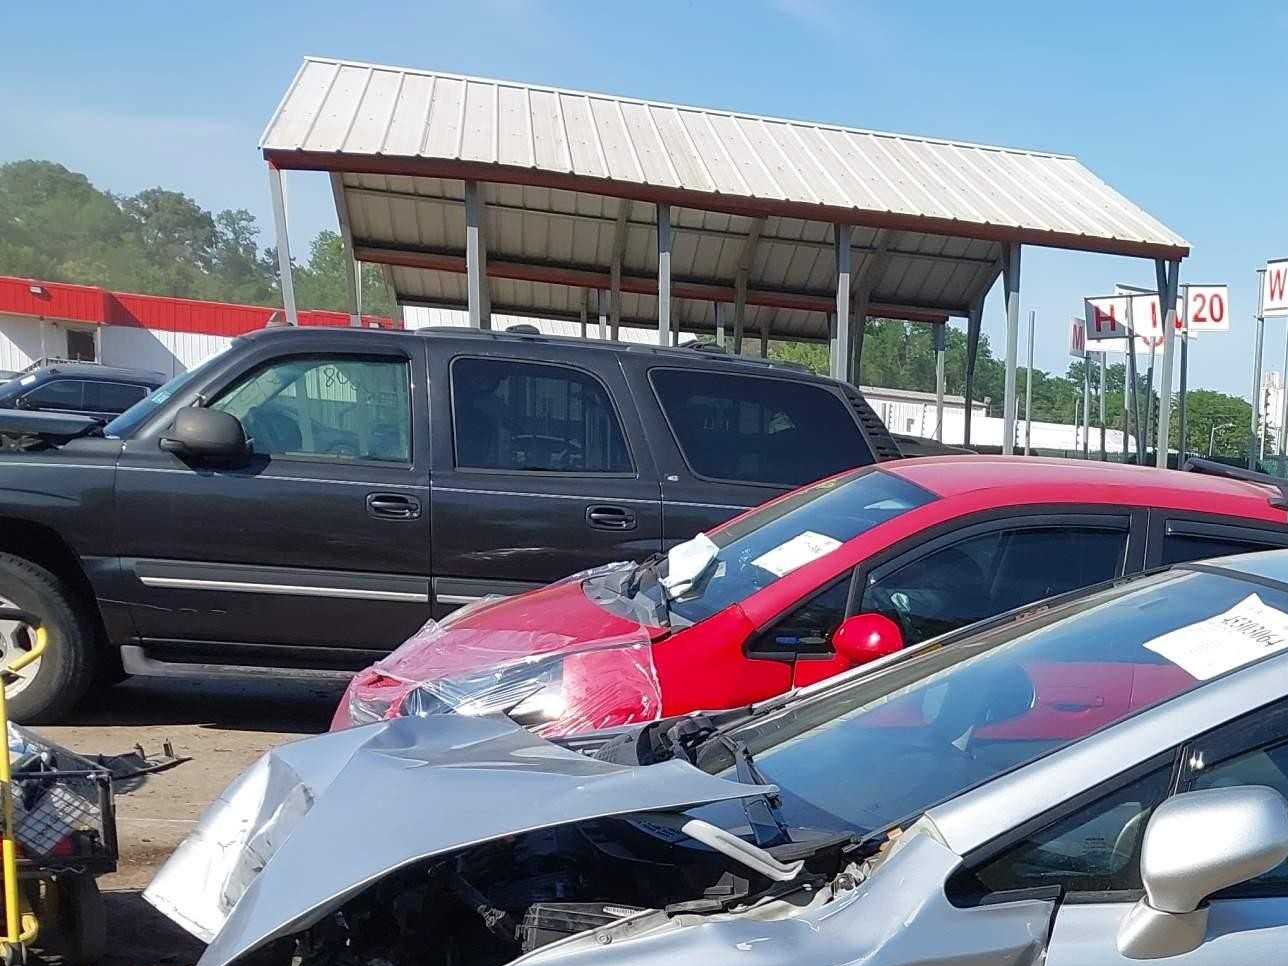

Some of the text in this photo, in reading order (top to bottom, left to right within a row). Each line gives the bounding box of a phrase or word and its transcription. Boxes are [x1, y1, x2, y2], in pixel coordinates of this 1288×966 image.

[1268, 267, 1288, 302] W
[1093, 303, 1117, 333] H
[1191, 293, 1225, 323] 20
